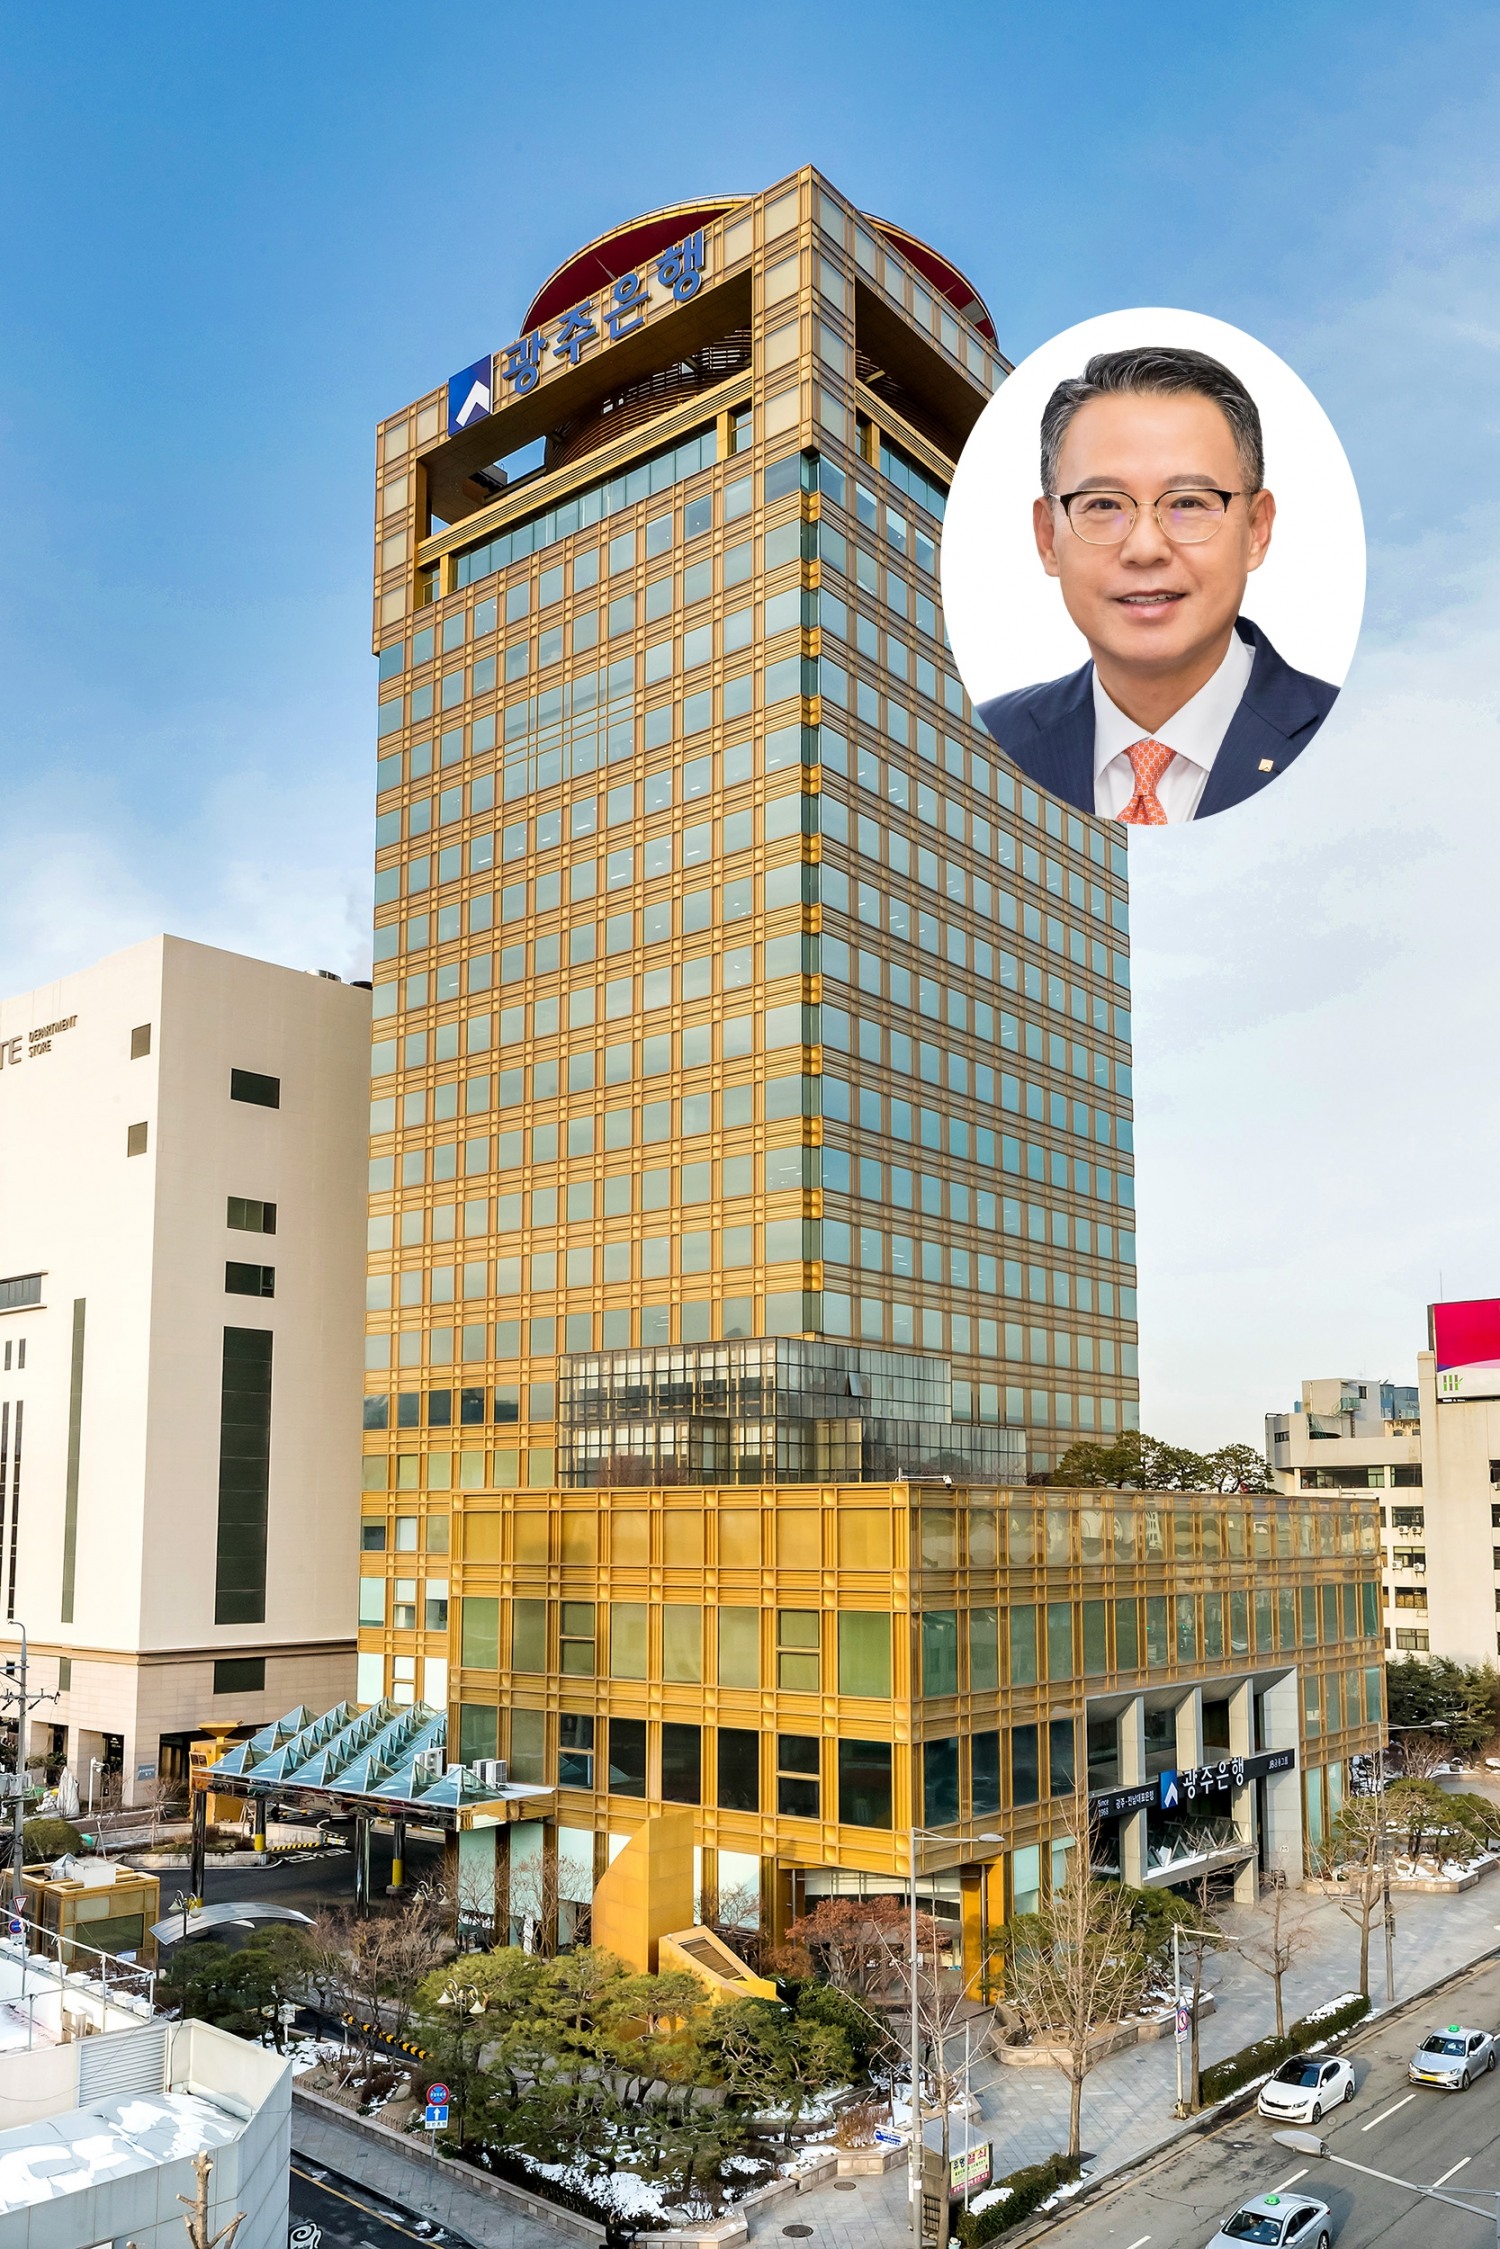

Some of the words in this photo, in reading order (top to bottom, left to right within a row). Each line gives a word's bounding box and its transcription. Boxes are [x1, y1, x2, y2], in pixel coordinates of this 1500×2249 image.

[502, 230, 704, 394] 광주은행
[28, 1015, 78, 1043] DEPARTMENT
[28, 1040, 52, 1058] STORE
[1182, 1756, 1245, 1799] 광주은행
[1097, 1799, 1109, 1807] Since
[1098, 1807, 1109, 1817] 1968
